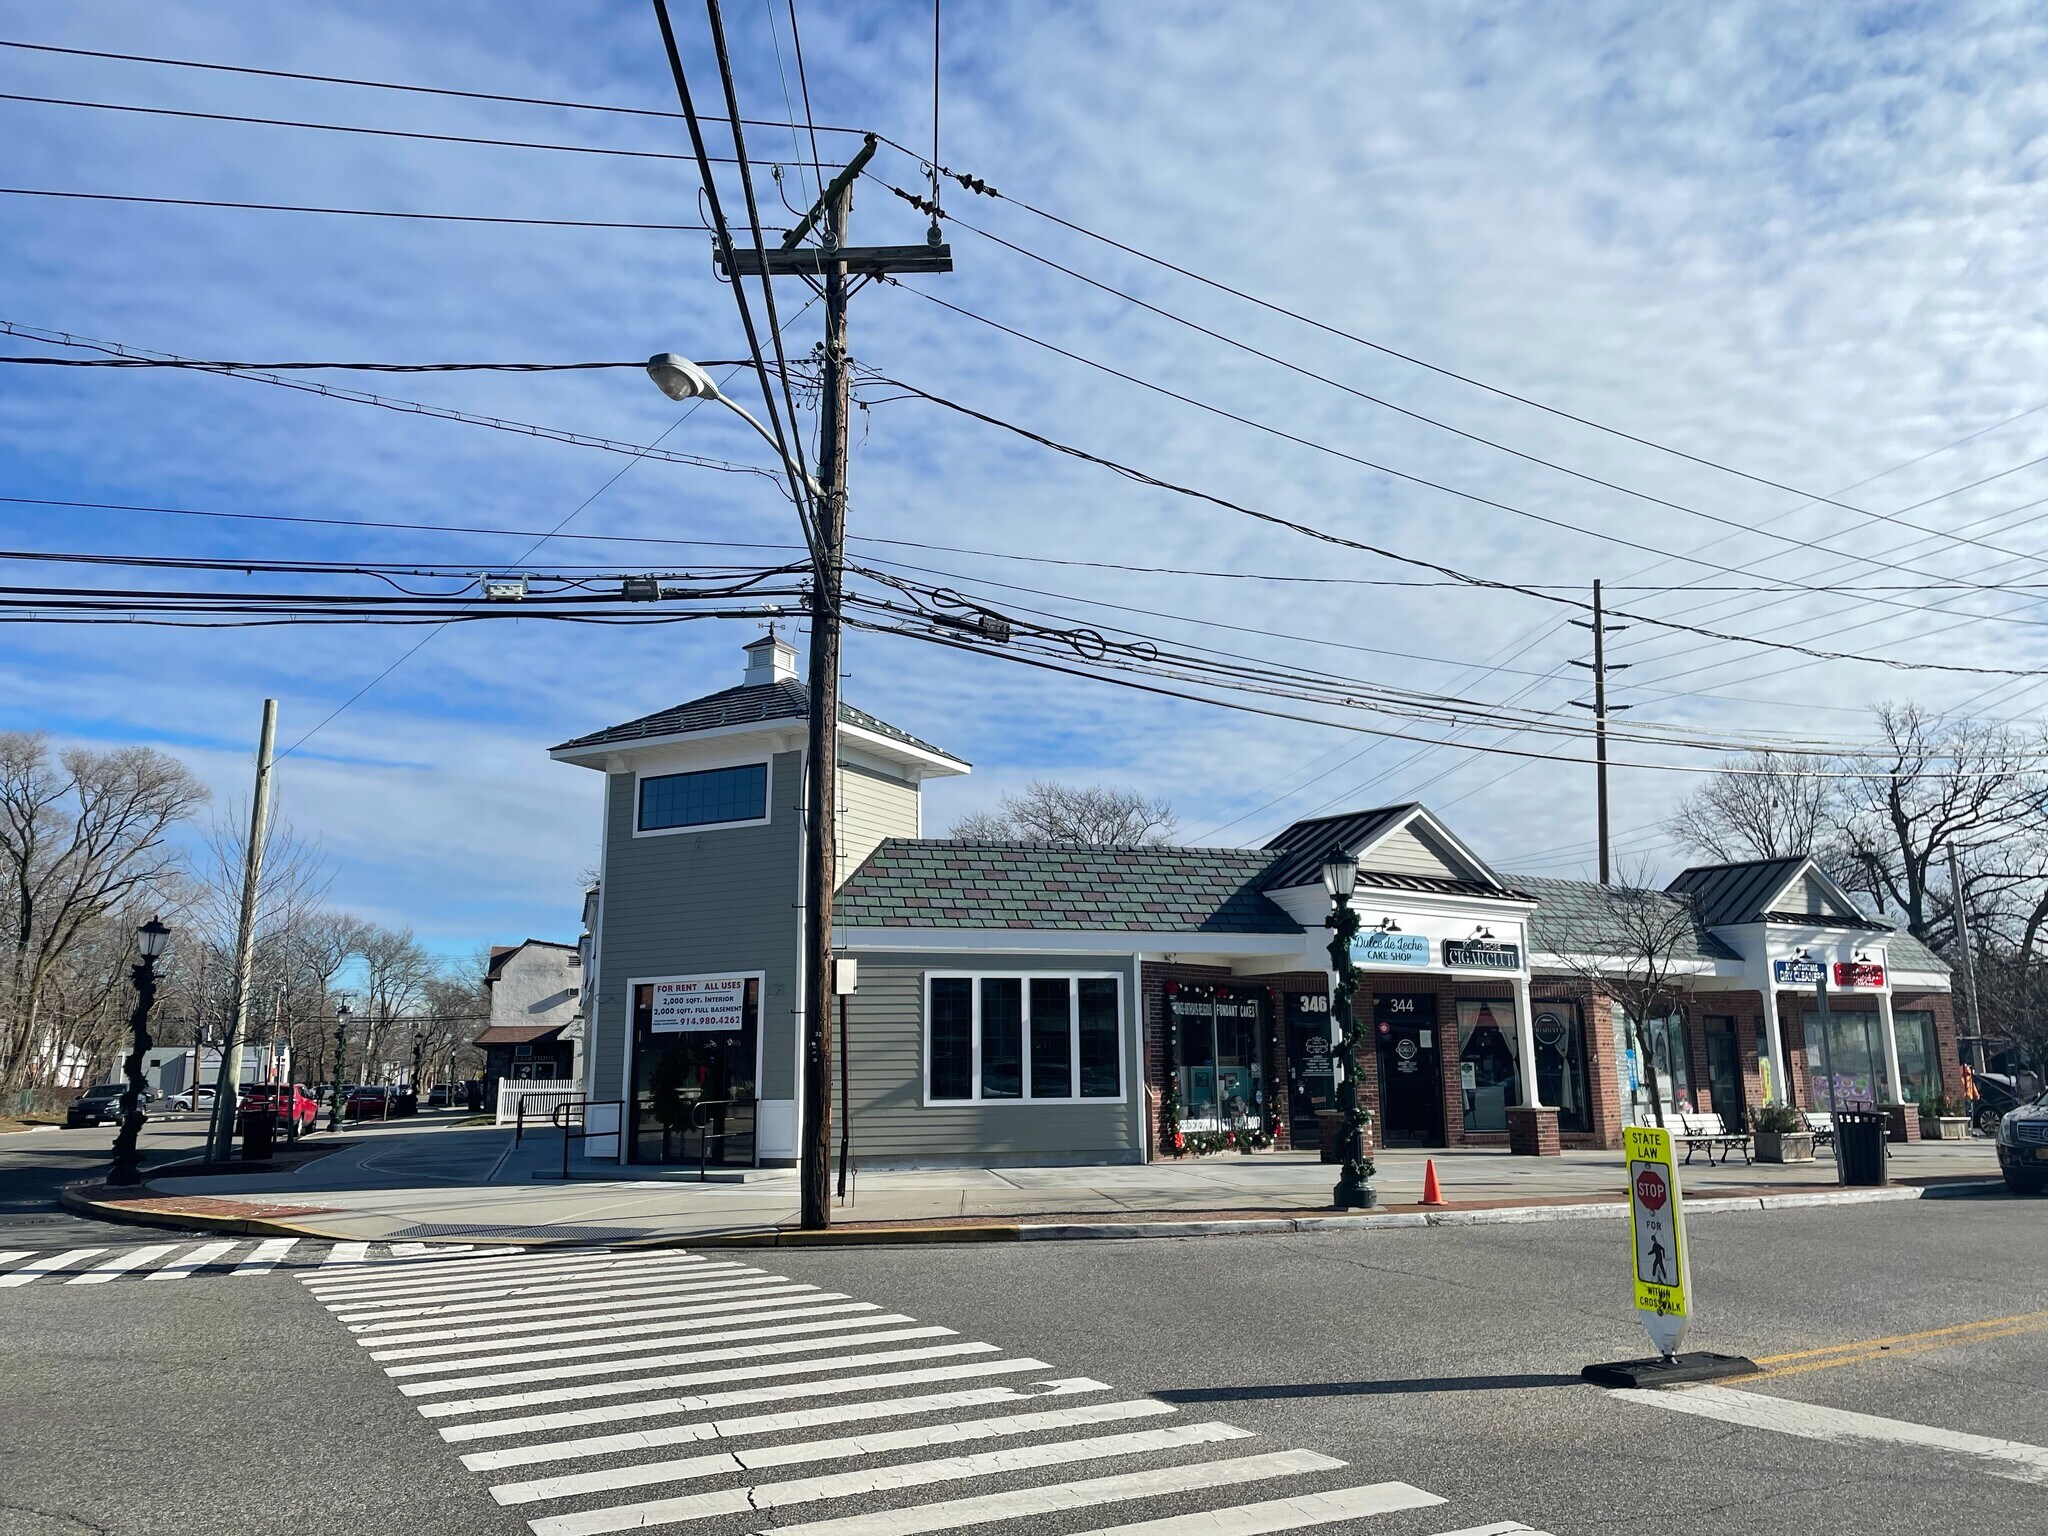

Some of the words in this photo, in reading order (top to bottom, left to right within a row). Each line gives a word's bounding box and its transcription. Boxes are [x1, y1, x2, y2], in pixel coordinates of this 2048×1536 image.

[1354, 934, 1383, 949] Dulce
[1384, 936, 1396, 949] de
[1397, 937, 1424, 952] Leche
[1367, 950, 1388, 960] CAKE
[1390, 951, 1412, 962] SHOP
[1449, 950, 1485, 965] CIGAR
[1486, 952, 1515, 967] CLUB
[1779, 970, 1793, 981] DRY
[657, 984, 673, 993] FOR
[676, 983, 698, 992] RENT
[704, 982, 719, 991] ALL
[721, 981, 741, 990] USES
[663, 997, 684, 1006] 2,000
[685, 997, 702, 1005] SQFT.
[704, 995, 734, 1003] INTERIOR
[1300, 995, 1328, 1013] 346
[1390, 998, 1415, 1013] 344
[653, 1007, 675, 1016] 2,000
[676, 1007, 693, 1015] SQFT.
[695, 1006, 709, 1014] FULL
[710, 1005, 742, 1013] BASEMENT
[1216, 1004, 1238, 1017] FONDANT
[1240, 1005, 1256, 1018] CAKES
[680, 1016, 740, 1026] 914.980.4262
[1632, 1132, 1661, 1146] STATE
[1637, 1146, 1658, 1159] LAW
[1638, 1182, 1664, 1198] STOP
[1646, 1220, 1662, 1231] FOR
[1647, 1287, 1671, 1298] WITHIN
